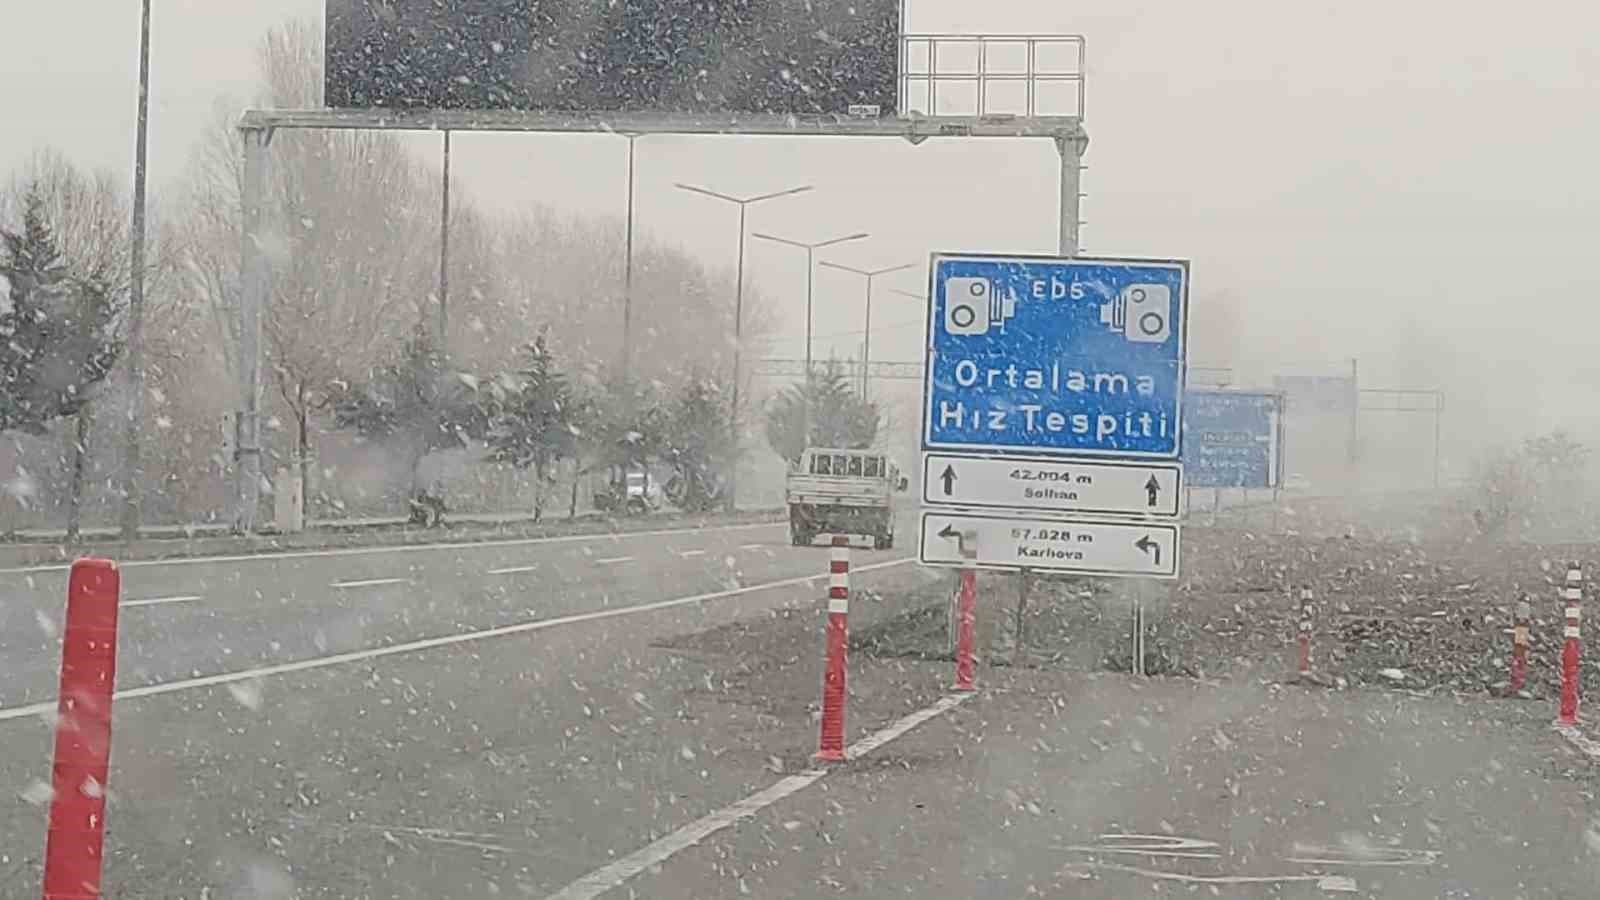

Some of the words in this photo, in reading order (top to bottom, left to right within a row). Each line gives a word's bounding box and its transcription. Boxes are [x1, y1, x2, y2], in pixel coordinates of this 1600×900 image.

[954, 359, 1156, 397] Ortalama
[939, 400, 1008, 433] Hız
[1017, 403, 1169, 441] Tespiti
[1075, 475, 1093, 485] m
[1076, 533, 1093, 543] m
